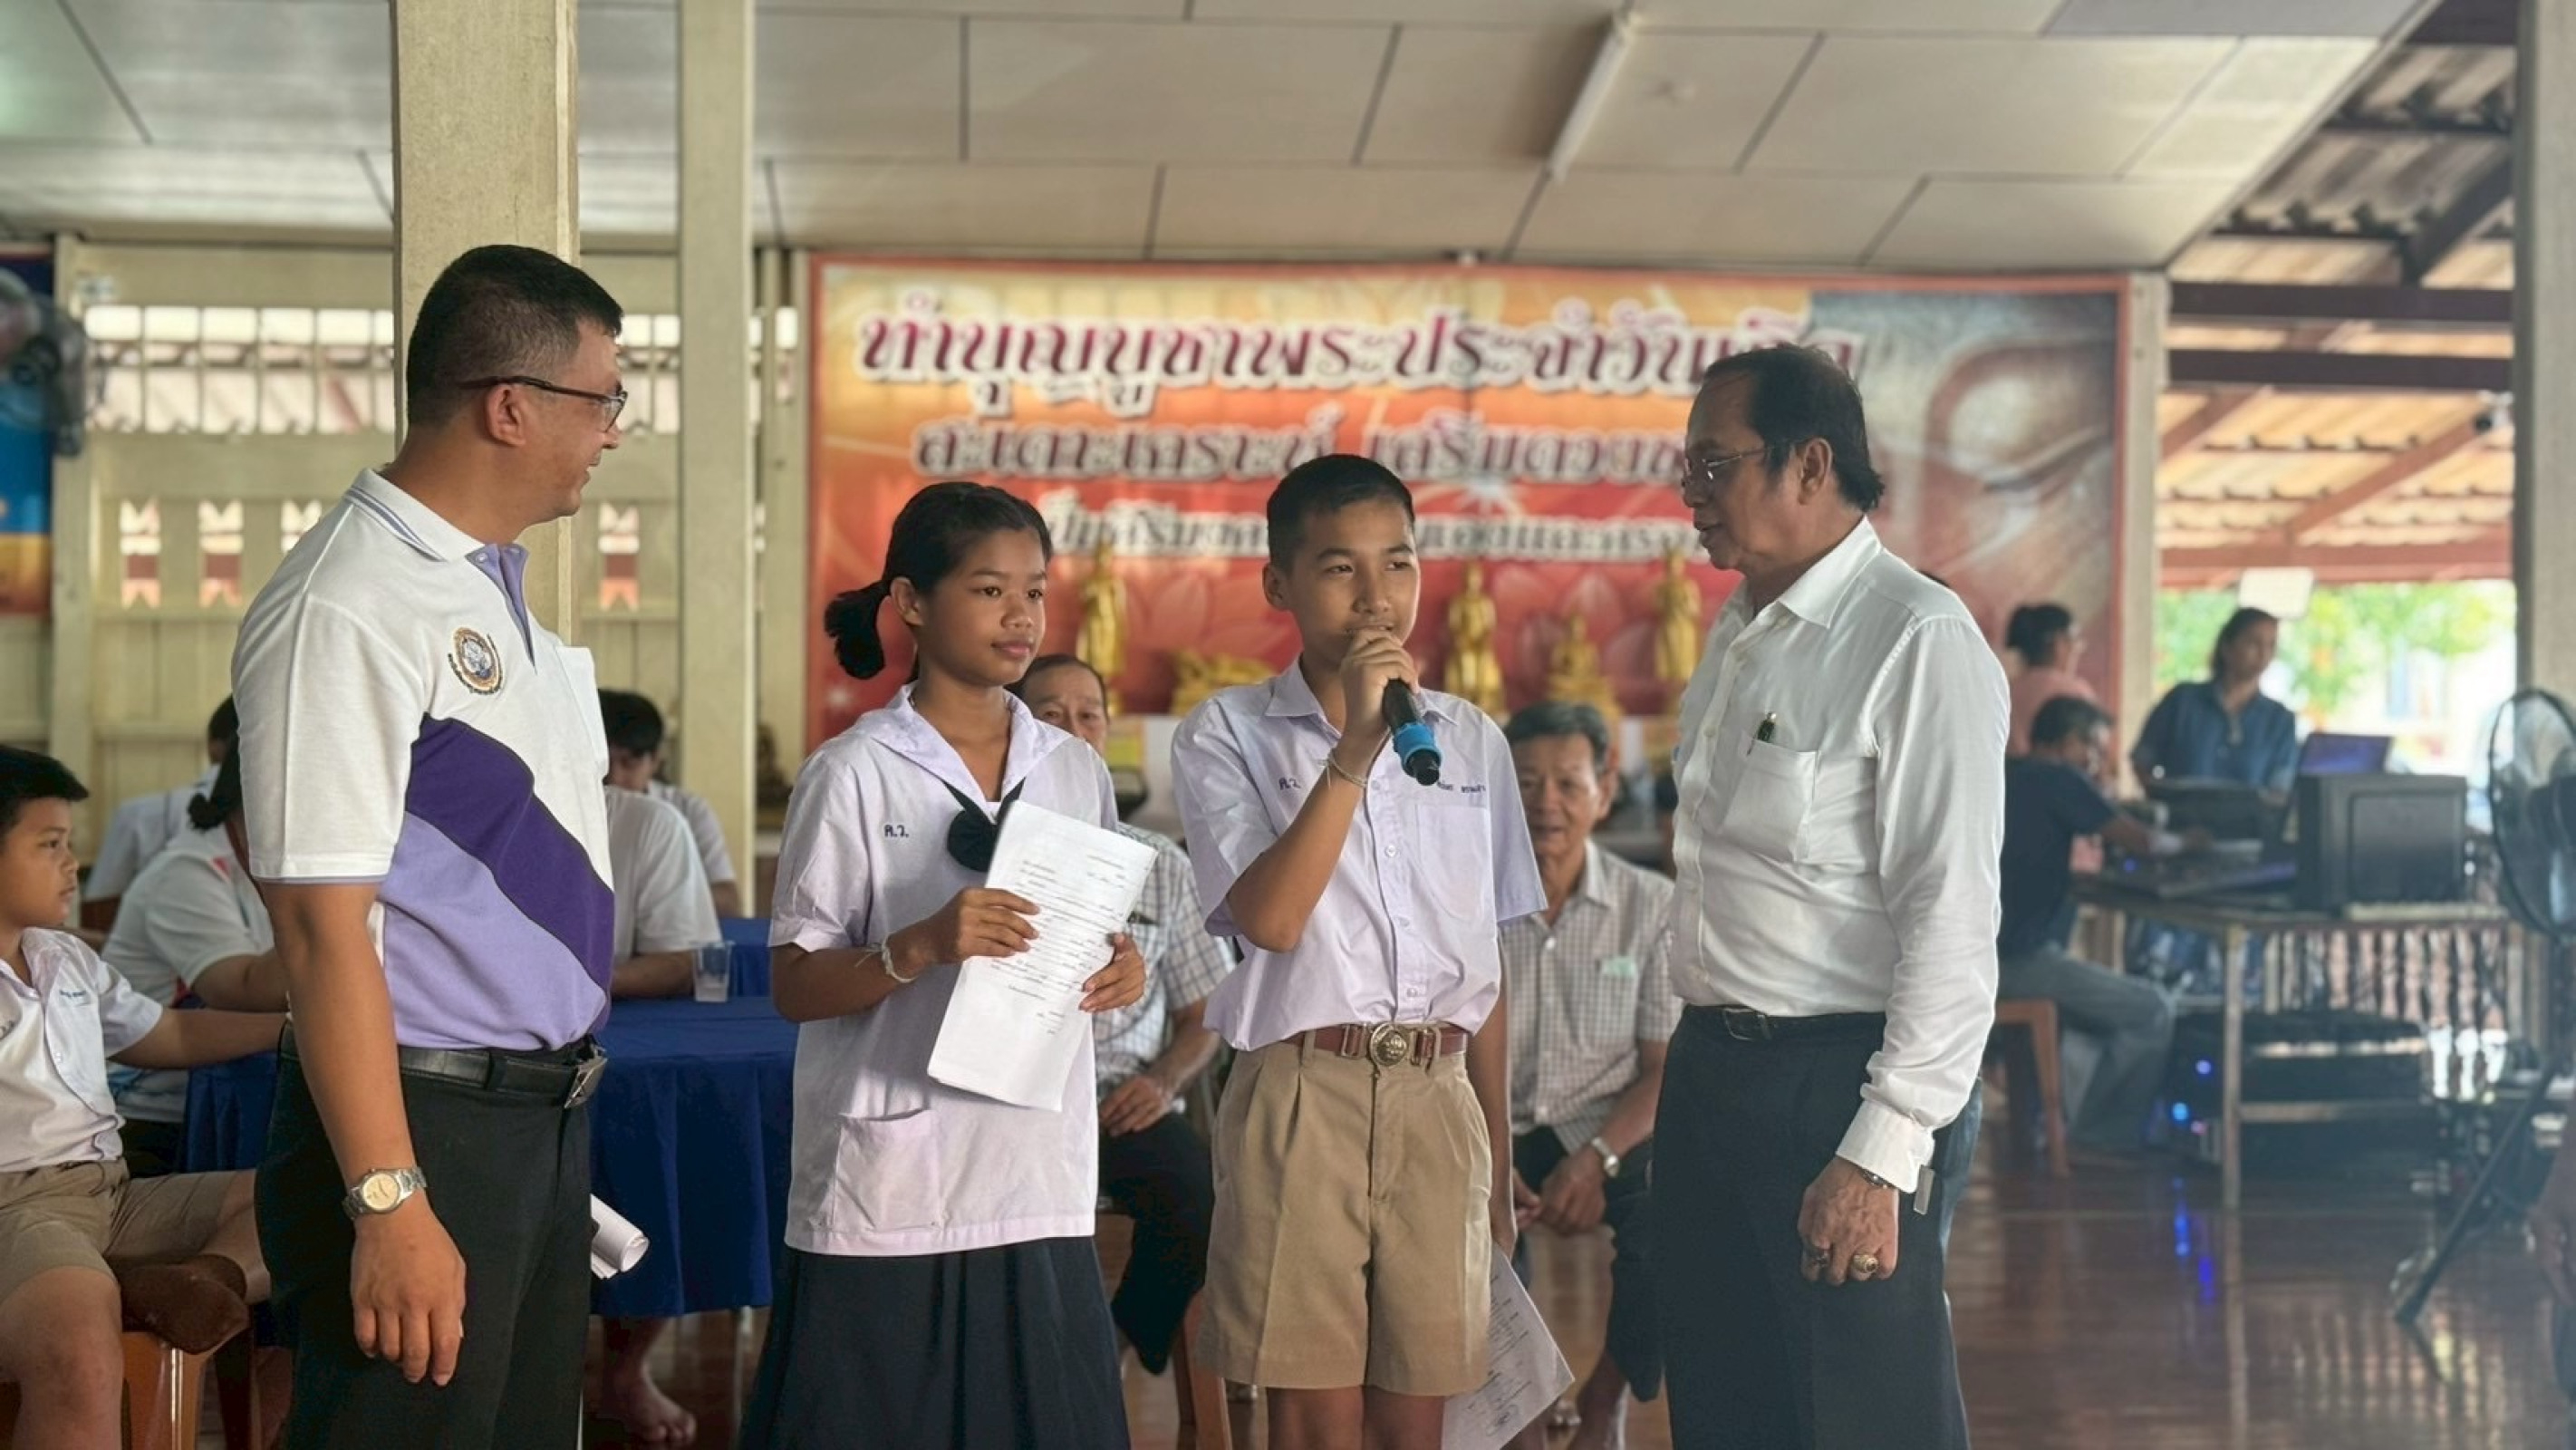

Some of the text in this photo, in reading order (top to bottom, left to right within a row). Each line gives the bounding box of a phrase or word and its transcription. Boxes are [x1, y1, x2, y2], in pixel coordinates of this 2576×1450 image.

[859, 290, 1854, 407] ทำบุญบูชาพระประจำวันิ
